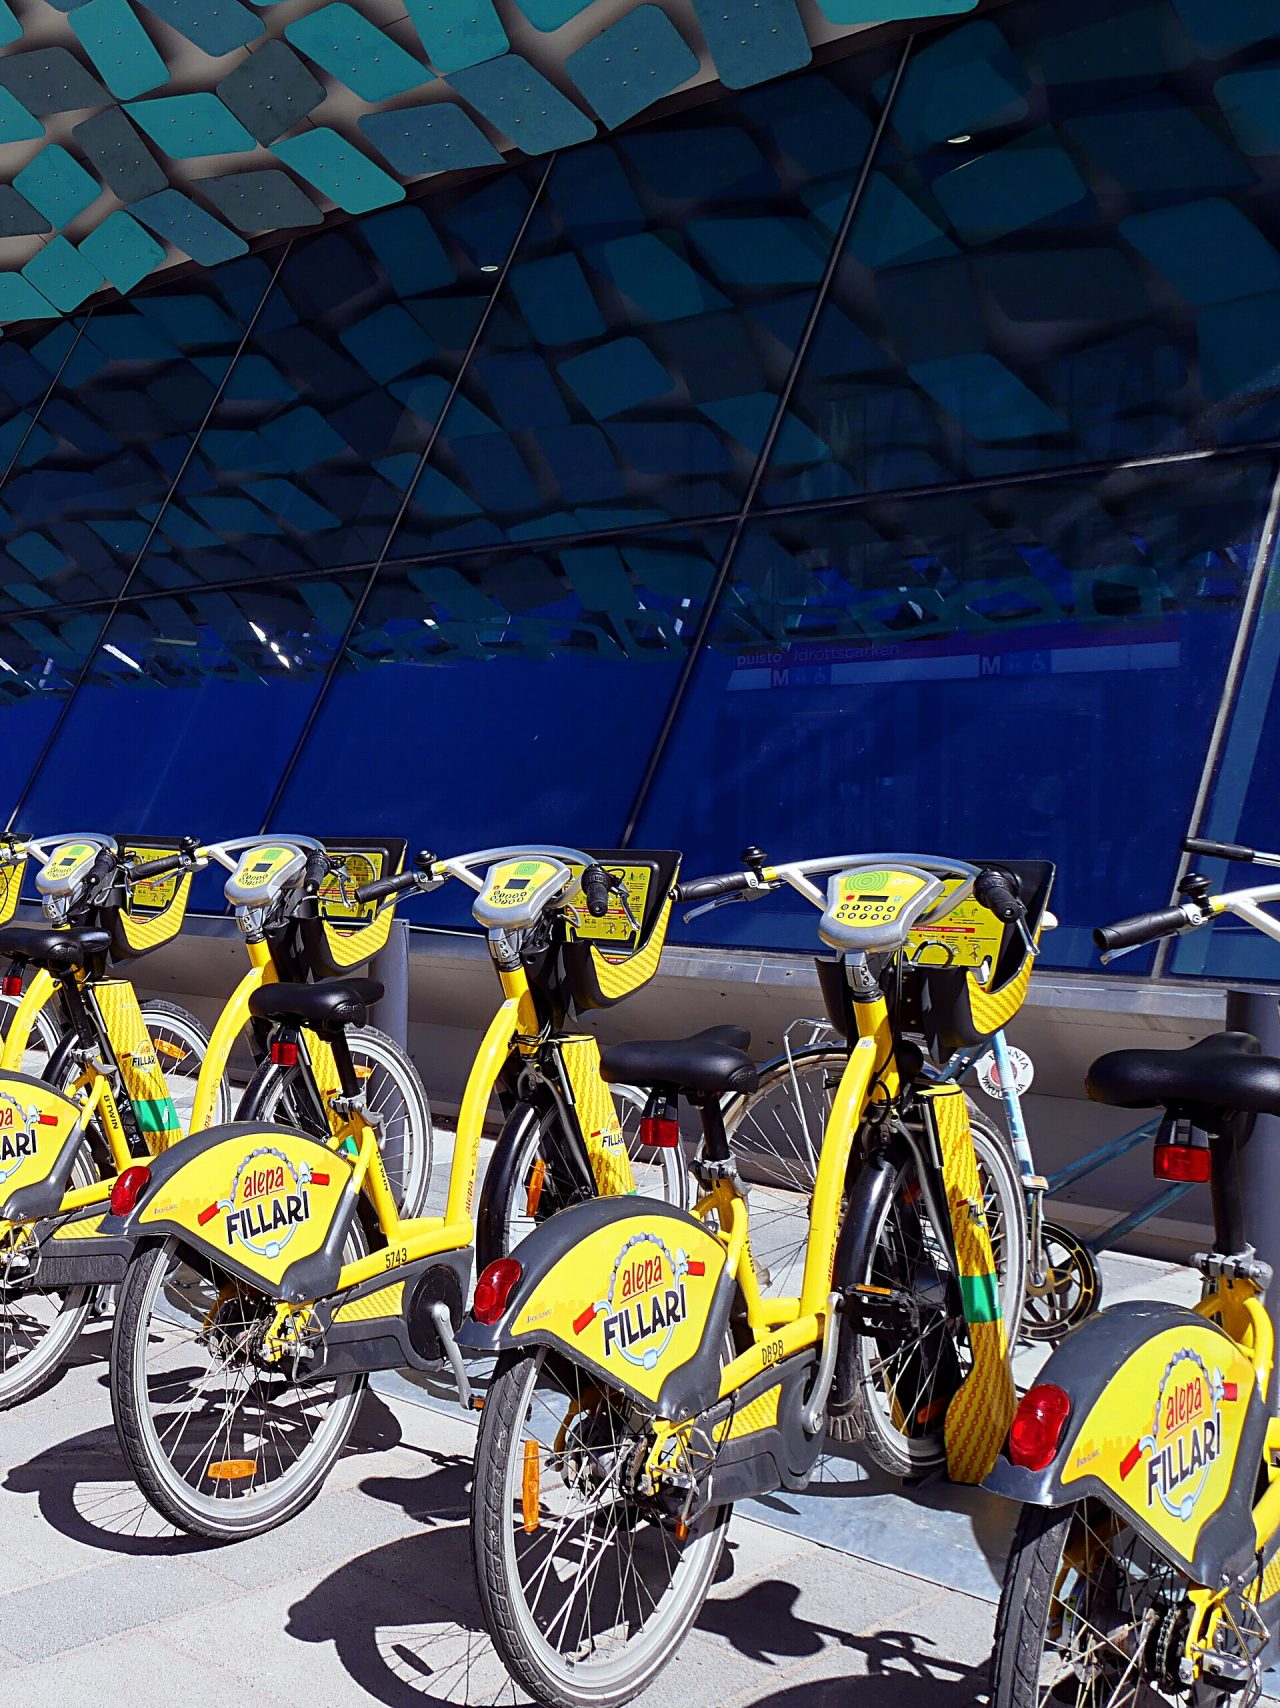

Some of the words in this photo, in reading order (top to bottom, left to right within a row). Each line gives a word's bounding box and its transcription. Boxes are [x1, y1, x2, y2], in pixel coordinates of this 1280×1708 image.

[981, 655, 1001, 675] M
[243, 1165, 285, 1199] alepa
[226, 1190, 311, 1246] FILLARI
[385, 1247, 408, 1270] 5743
[622, 1254, 664, 1298] alepa
[604, 1284, 687, 1358] FILLARI
[1166, 1376, 1203, 1432] alepa
[1146, 1410, 1222, 1507] FILLARI
